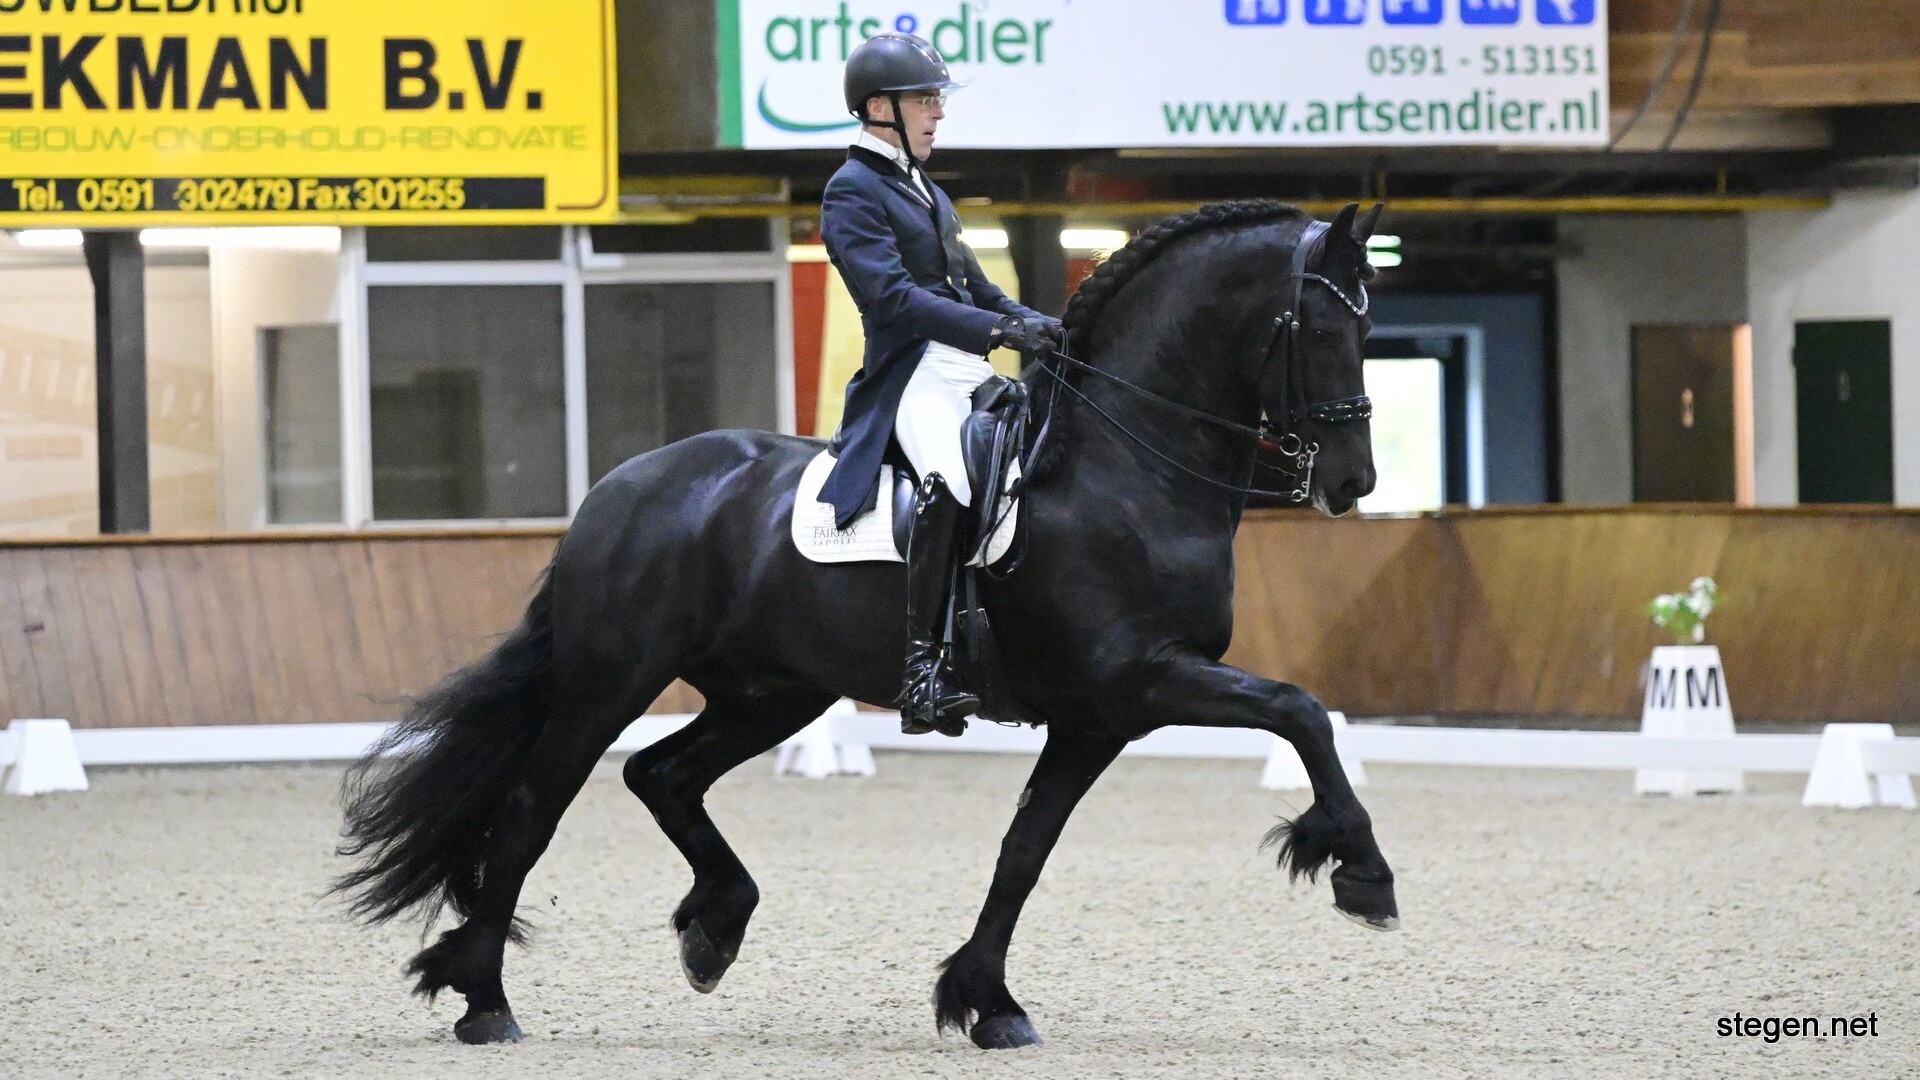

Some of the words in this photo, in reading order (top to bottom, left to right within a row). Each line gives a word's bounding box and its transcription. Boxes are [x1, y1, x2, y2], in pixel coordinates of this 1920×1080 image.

[0, 36, 328, 110] EKMAN
[384, 38, 543, 110] B.V.
[1368, 46, 1446, 74] 0591
[1483, 46, 1597, 74] 513151
[1163, 90, 1600, 133] www.artsendier.nl
[12, 180, 63, 211] Tel.
[77, 179, 153, 211] 0591
[299, 179, 350, 210] Fax
[352, 178, 465, 210] 301255
